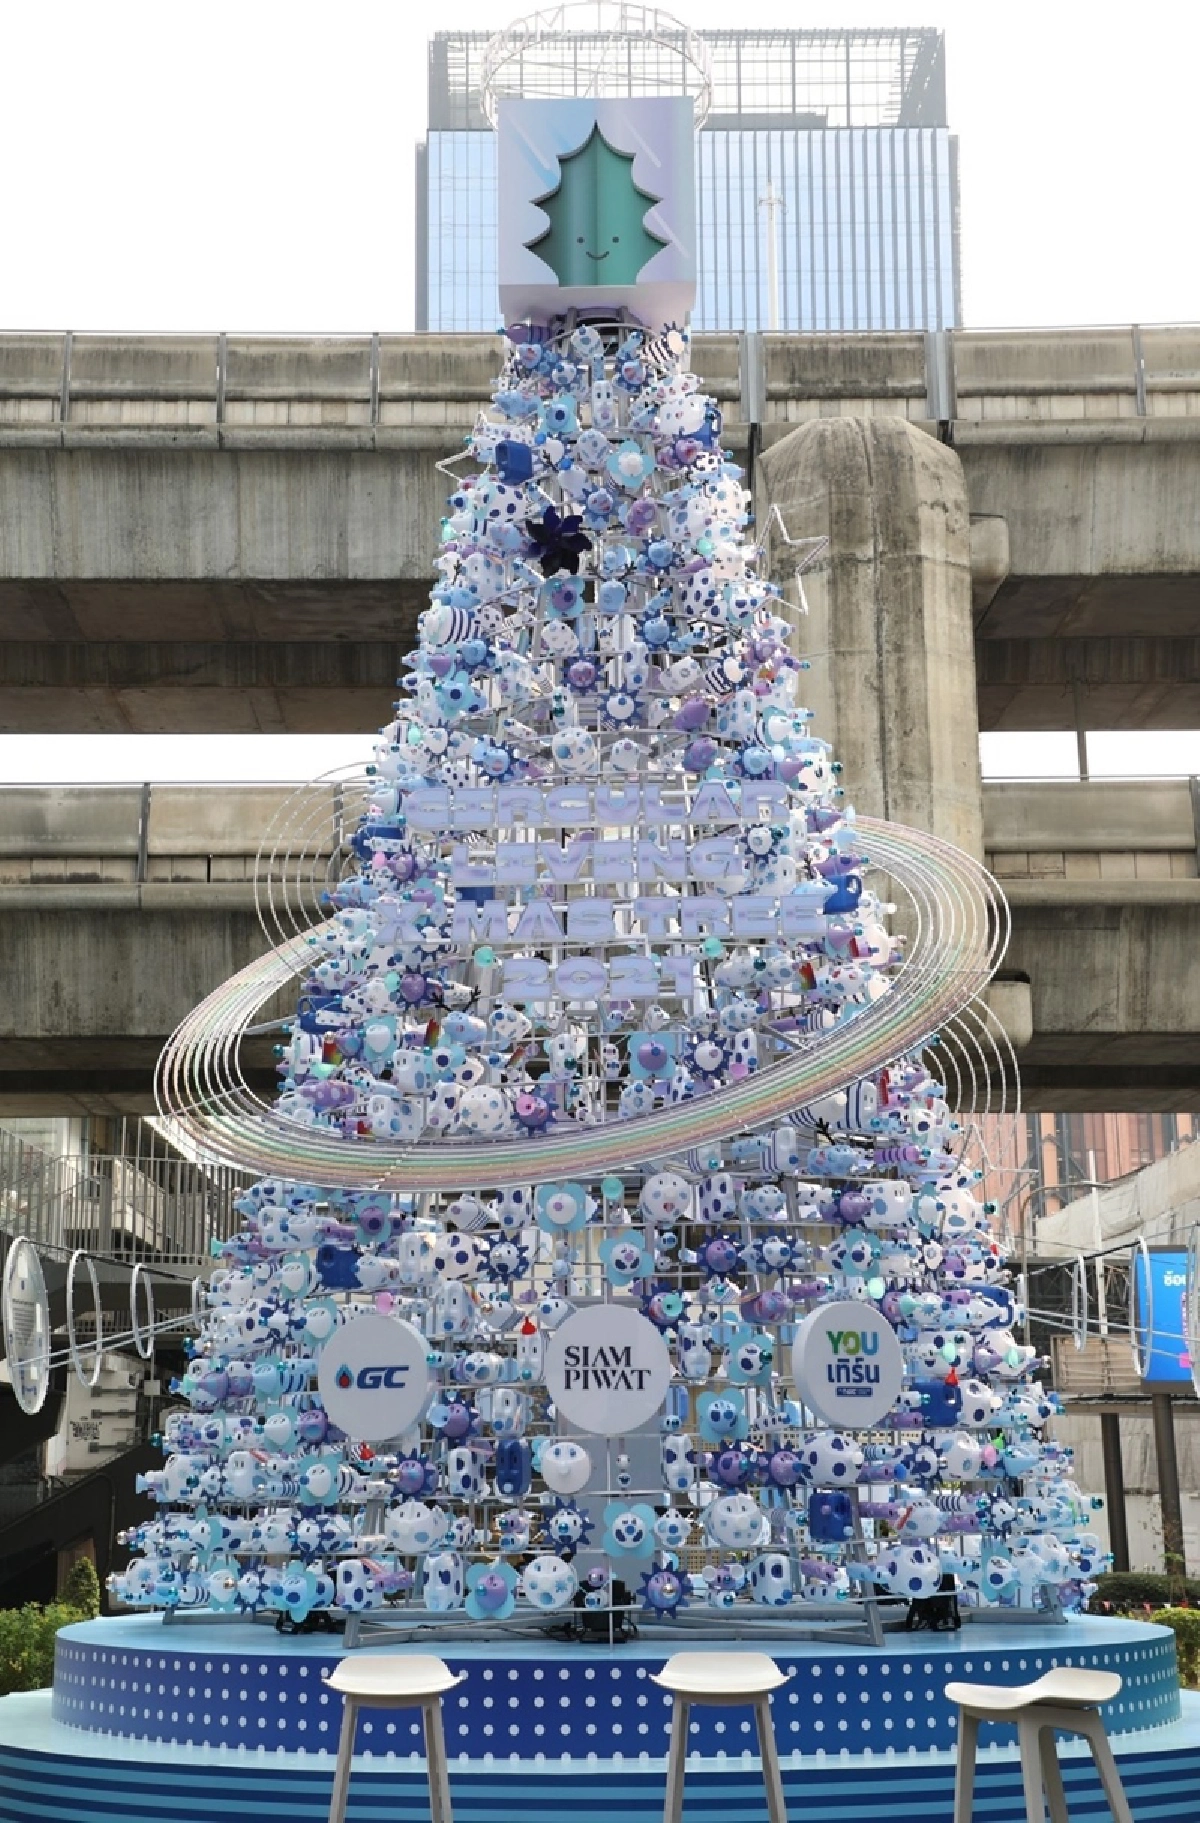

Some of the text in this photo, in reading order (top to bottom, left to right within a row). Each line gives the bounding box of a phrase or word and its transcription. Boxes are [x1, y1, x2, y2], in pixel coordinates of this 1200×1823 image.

[402, 781, 790, 827] CIRCULAR
[452, 840, 743, 881] LIVING
[372, 895, 828, 942] X'MAS TREE
[503, 956, 694, 999] 2021
[564, 1346, 631, 1367] SIAM
[826, 1331, 878, 1355] YOU
[357, 1366, 409, 1389] GC
[564, 1369, 652, 1390] PIWAT
